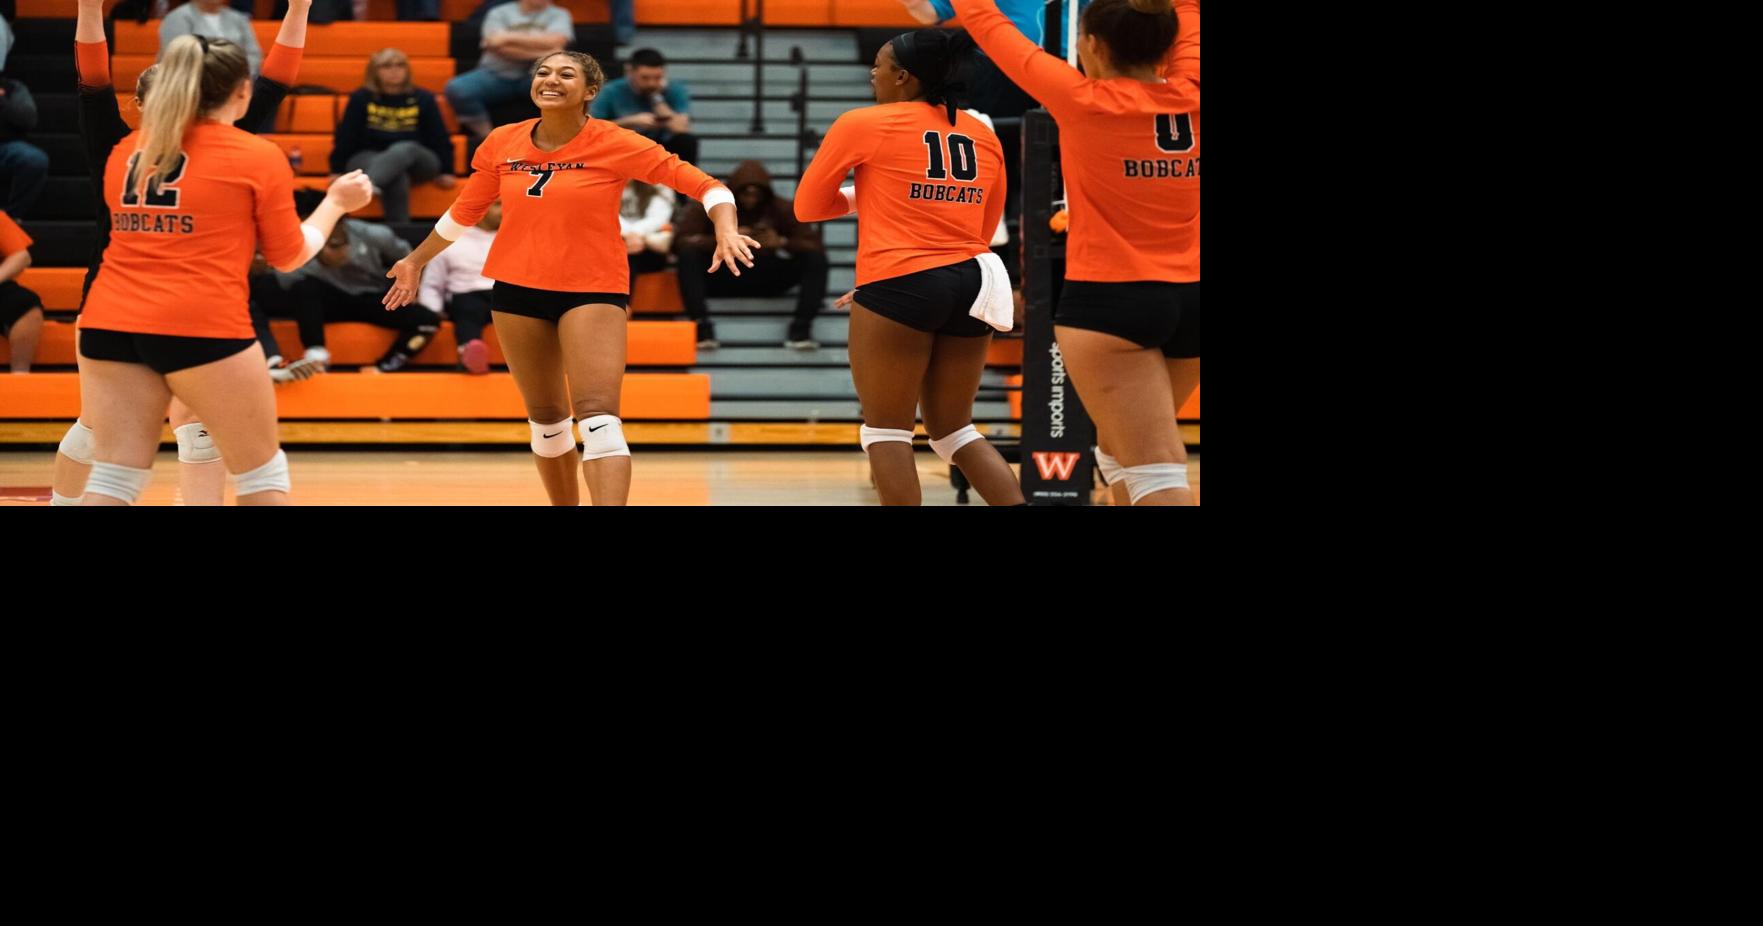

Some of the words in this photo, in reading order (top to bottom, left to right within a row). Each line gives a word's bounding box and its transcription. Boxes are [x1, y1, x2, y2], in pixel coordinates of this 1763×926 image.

[508, 161, 584, 172] WESLEYAN
[923, 130, 978, 182] 10
[121, 149, 188, 209] 12
[526, 170, 554, 197] 7
[910, 182, 983, 204] BOBCATS
[1049, 342, 1066, 384] sports
[1048, 386, 1066, 438] imports
[1032, 451, 1080, 480] W
